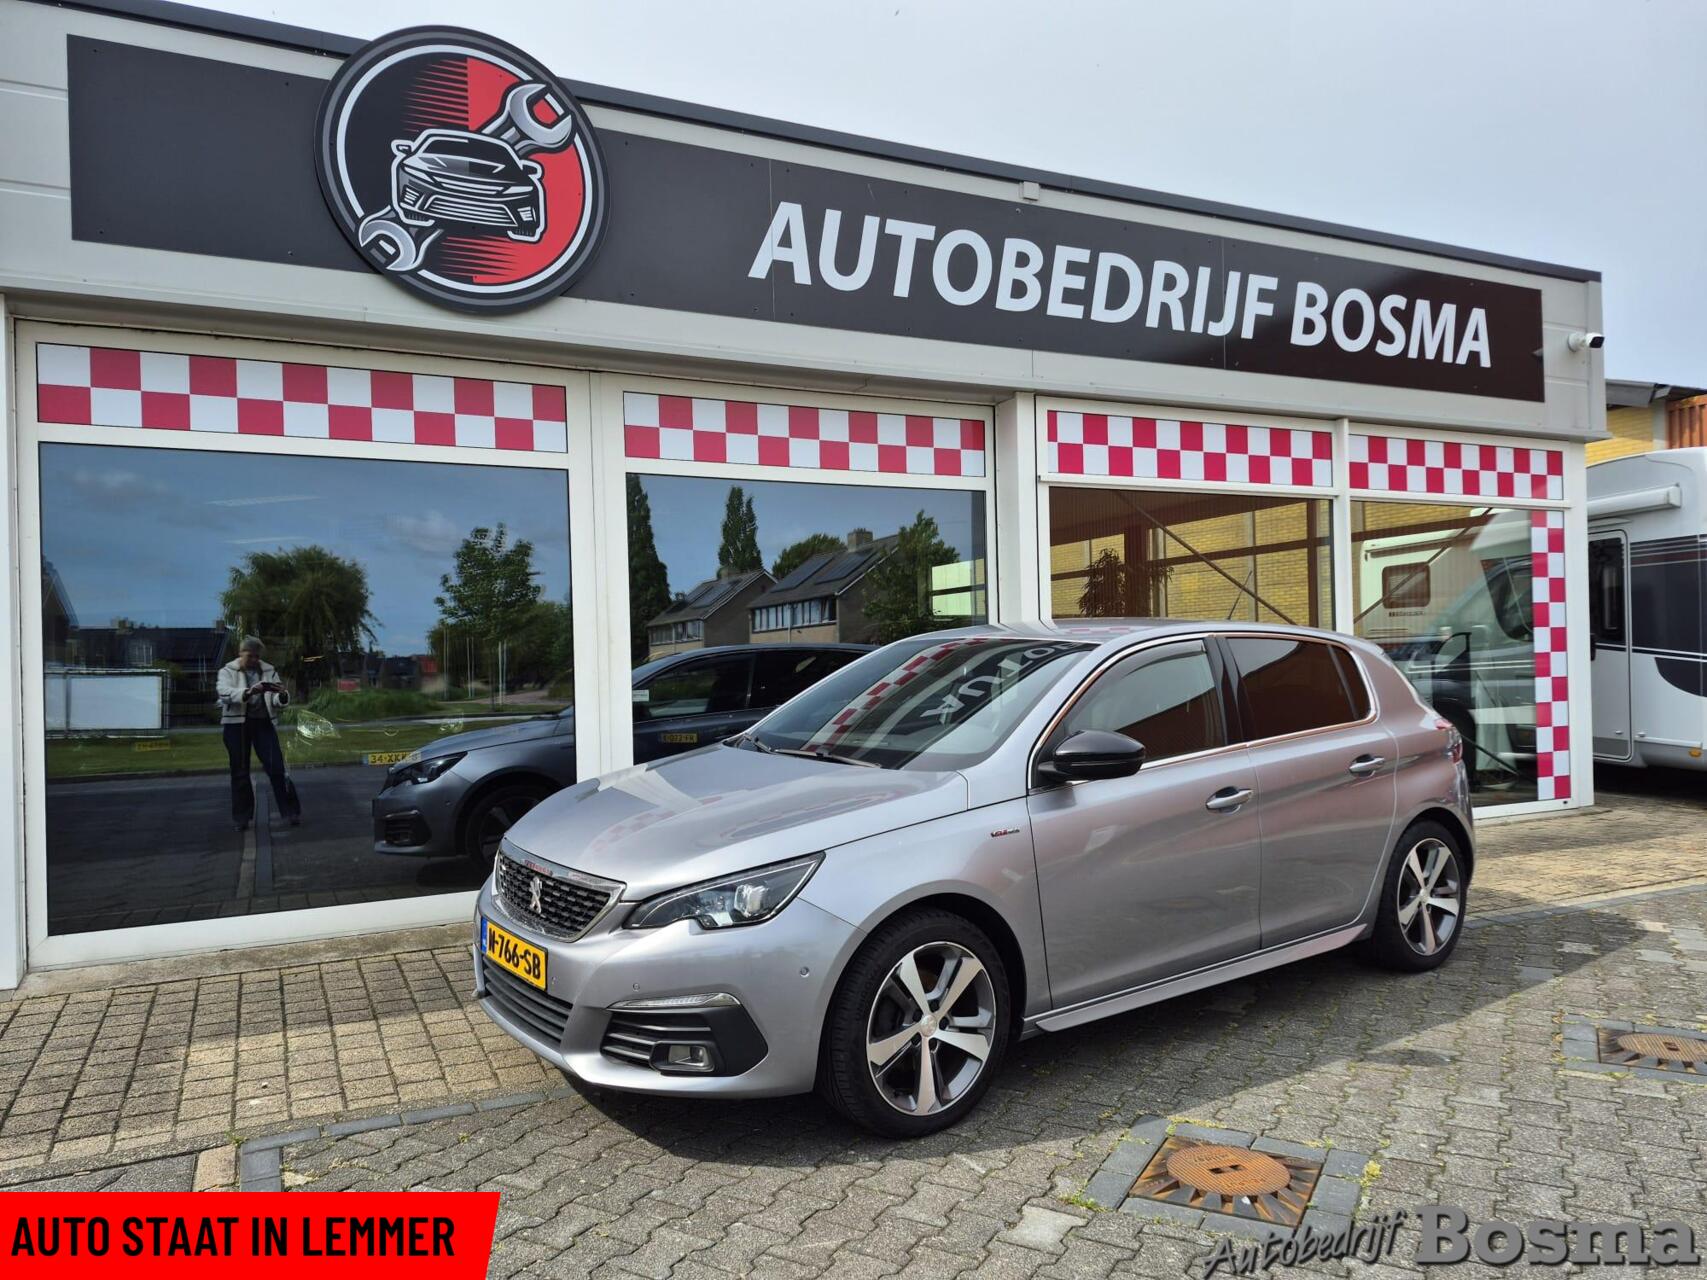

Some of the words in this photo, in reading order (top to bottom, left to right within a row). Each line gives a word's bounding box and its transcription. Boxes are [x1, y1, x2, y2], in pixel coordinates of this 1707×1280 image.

[748, 202, 1279, 340] AUTOBEDRIJF
[1290, 281, 1491, 368] BOSMA
[488, 926, 542, 980] N-766-SB
